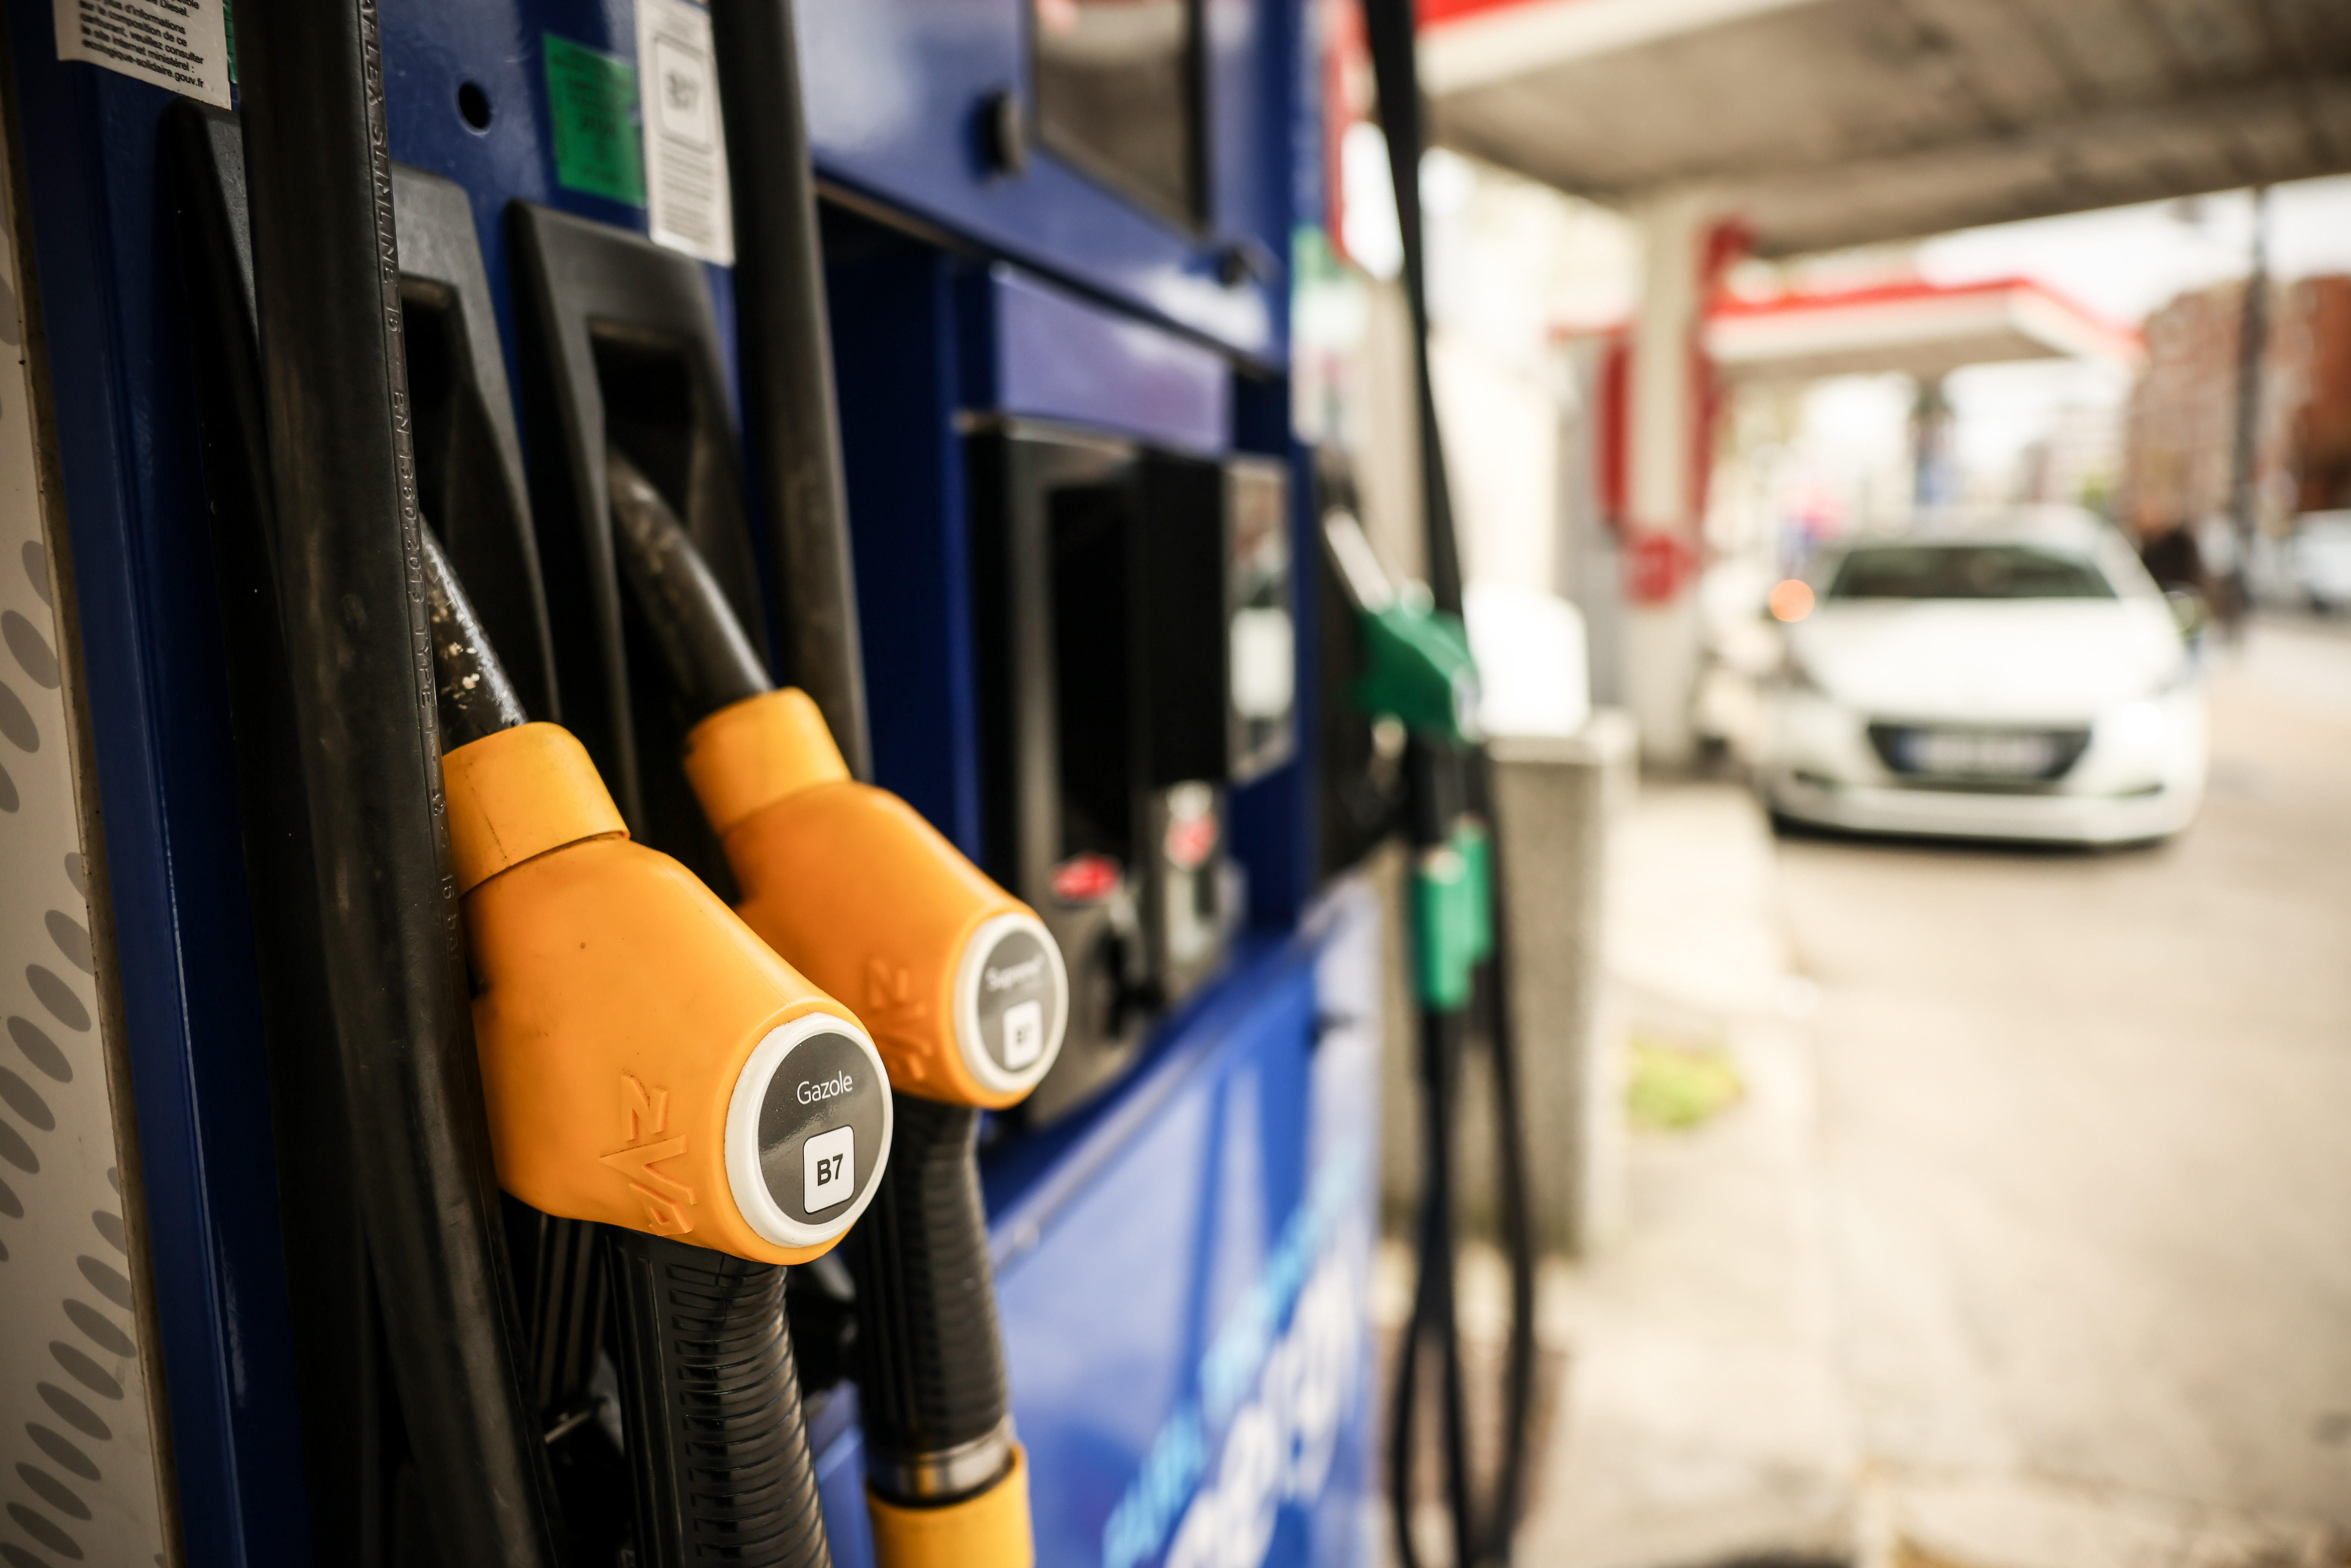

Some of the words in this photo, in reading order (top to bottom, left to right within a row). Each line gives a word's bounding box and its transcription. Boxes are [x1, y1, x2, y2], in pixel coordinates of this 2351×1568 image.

[125, 4, 186, 34] d'informations
[160, 0, 190, 17] Diesel.
[109, 11, 162, 38] composition
[163, 31, 175, 42] de
[177, 37, 187, 47] ce
[113, 35, 147, 56] internet
[129, 31, 163, 50] veuillez
[165, 45, 204, 65] consulter
[370, 124, 398, 285] SLIMLINE
[393, 392, 410, 435] EN
[415, 628, 436, 707] TYPE
[797, 1070, 853, 1105] Gazole
[817, 1153, 844, 1187] B7
